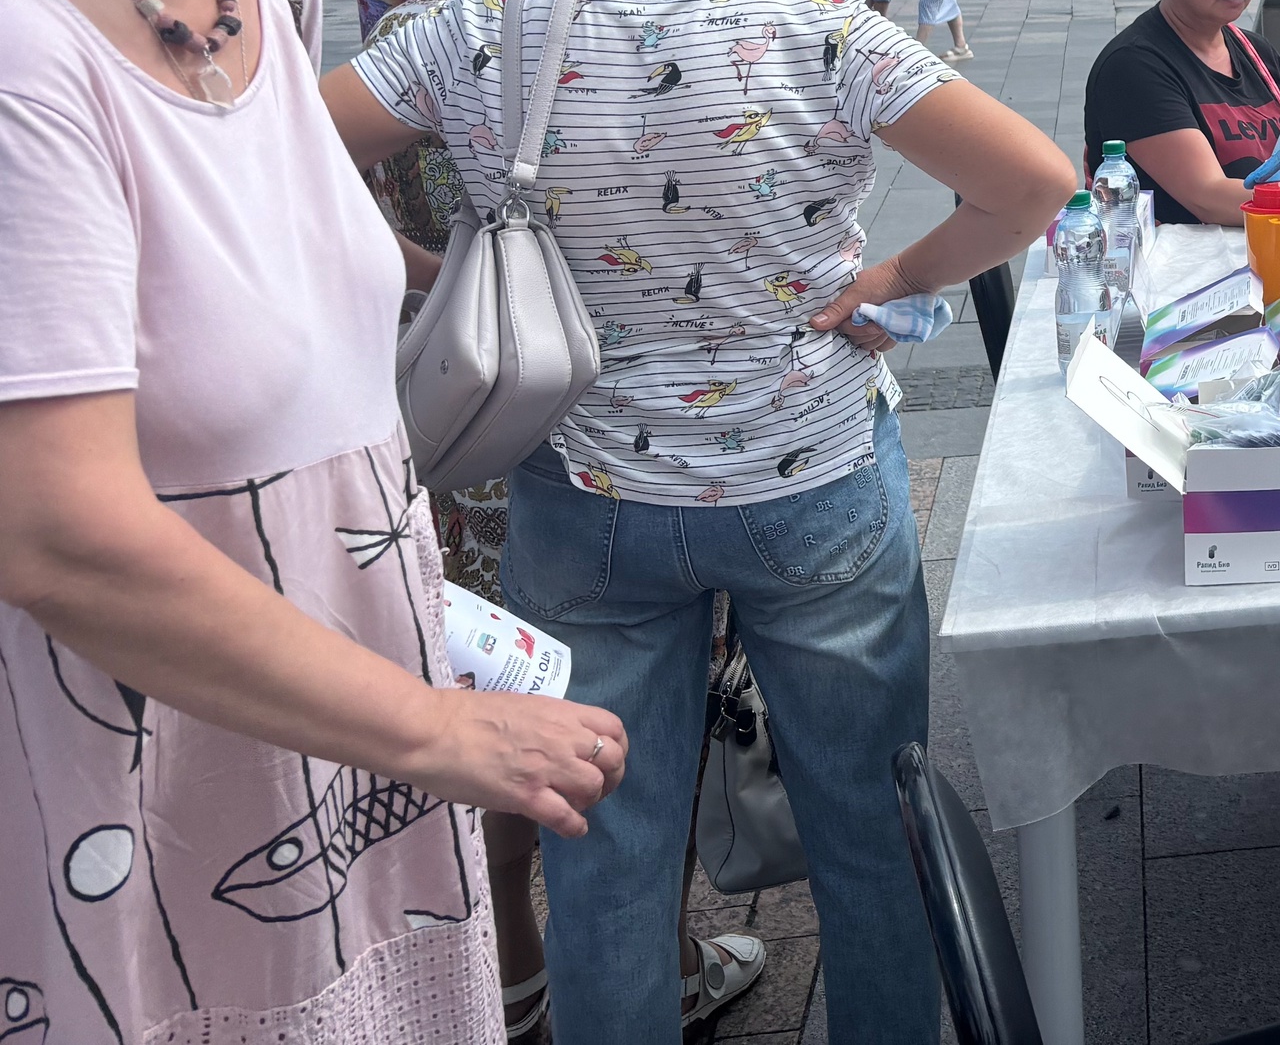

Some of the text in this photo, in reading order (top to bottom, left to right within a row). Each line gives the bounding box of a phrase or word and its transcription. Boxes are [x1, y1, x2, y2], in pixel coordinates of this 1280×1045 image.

[707, 17, 742, 26] ACTIVE
[597, 186, 629, 198] RELAX
[703, 205, 725, 220] RELAX
[641, 286, 670, 298] RELAX
[671, 320, 707, 329] ACTIVE
[798, 395, 825, 417] ACTIVE
[669, 454, 691, 469] RELAX
[853, 453, 875, 470] ACTIV
[815, 499, 834, 512] BR
[847, 508, 858, 523] B
[804, 534, 817, 547] R
[1196, 560, 1230, 569] Рапид Био
[538, 651, 551, 672] ЧТО
